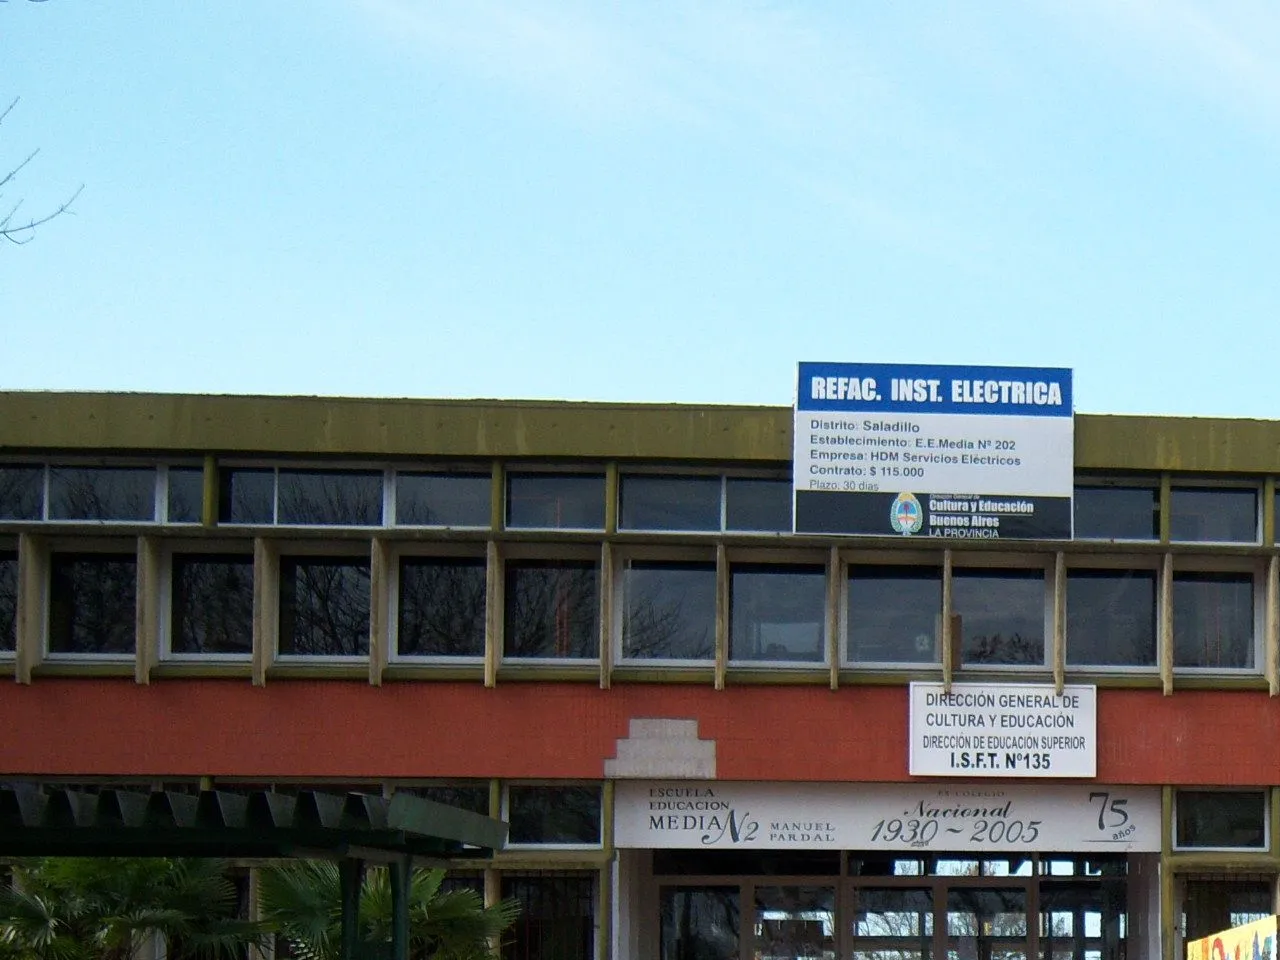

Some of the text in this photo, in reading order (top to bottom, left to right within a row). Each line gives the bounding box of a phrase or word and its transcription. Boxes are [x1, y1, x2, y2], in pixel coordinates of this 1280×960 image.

[811, 376, 1063, 406] REFAC. INST. ELECTRICA
[863, 420, 920, 433] Saladillo
[995, 440, 1016, 451] 202
[870, 451, 898, 461] HDM
[903, 452, 958, 464] Servicios
[961, 453, 1021, 466] Eléctricos
[809, 464, 924, 477] Contrato: $ 115.000
[843, 480, 856, 490] 30
[929, 499, 1034, 514] Cultura y Educación
[929, 514, 1000, 528] Buenos Aires
[929, 527, 1000, 539] LA PROVINCIA
[926, 691, 1080, 709] DIRECCIÓN GENERAL DE
[926, 711, 1075, 729] CULTURA Y EDUCACIÓN
[923, 732, 1086, 751] DIRECCIÓN DE EDUCACIÓN SUPERIOR
[950, 751, 1000, 769] I.S.F.T.
[649, 788, 715, 798] ESCUELA
[649, 801, 730, 811] EDUCACION
[903, 800, 1013, 819] Nacional
[1089, 791, 1129, 831] 75
[649, 815, 722, 831] MEDIA
[770, 822, 836, 832] MANUEL
[770, 833, 836, 843] PARDAL
[870, 819, 939, 843] 1930
[970, 820, 1043, 844] 2005
